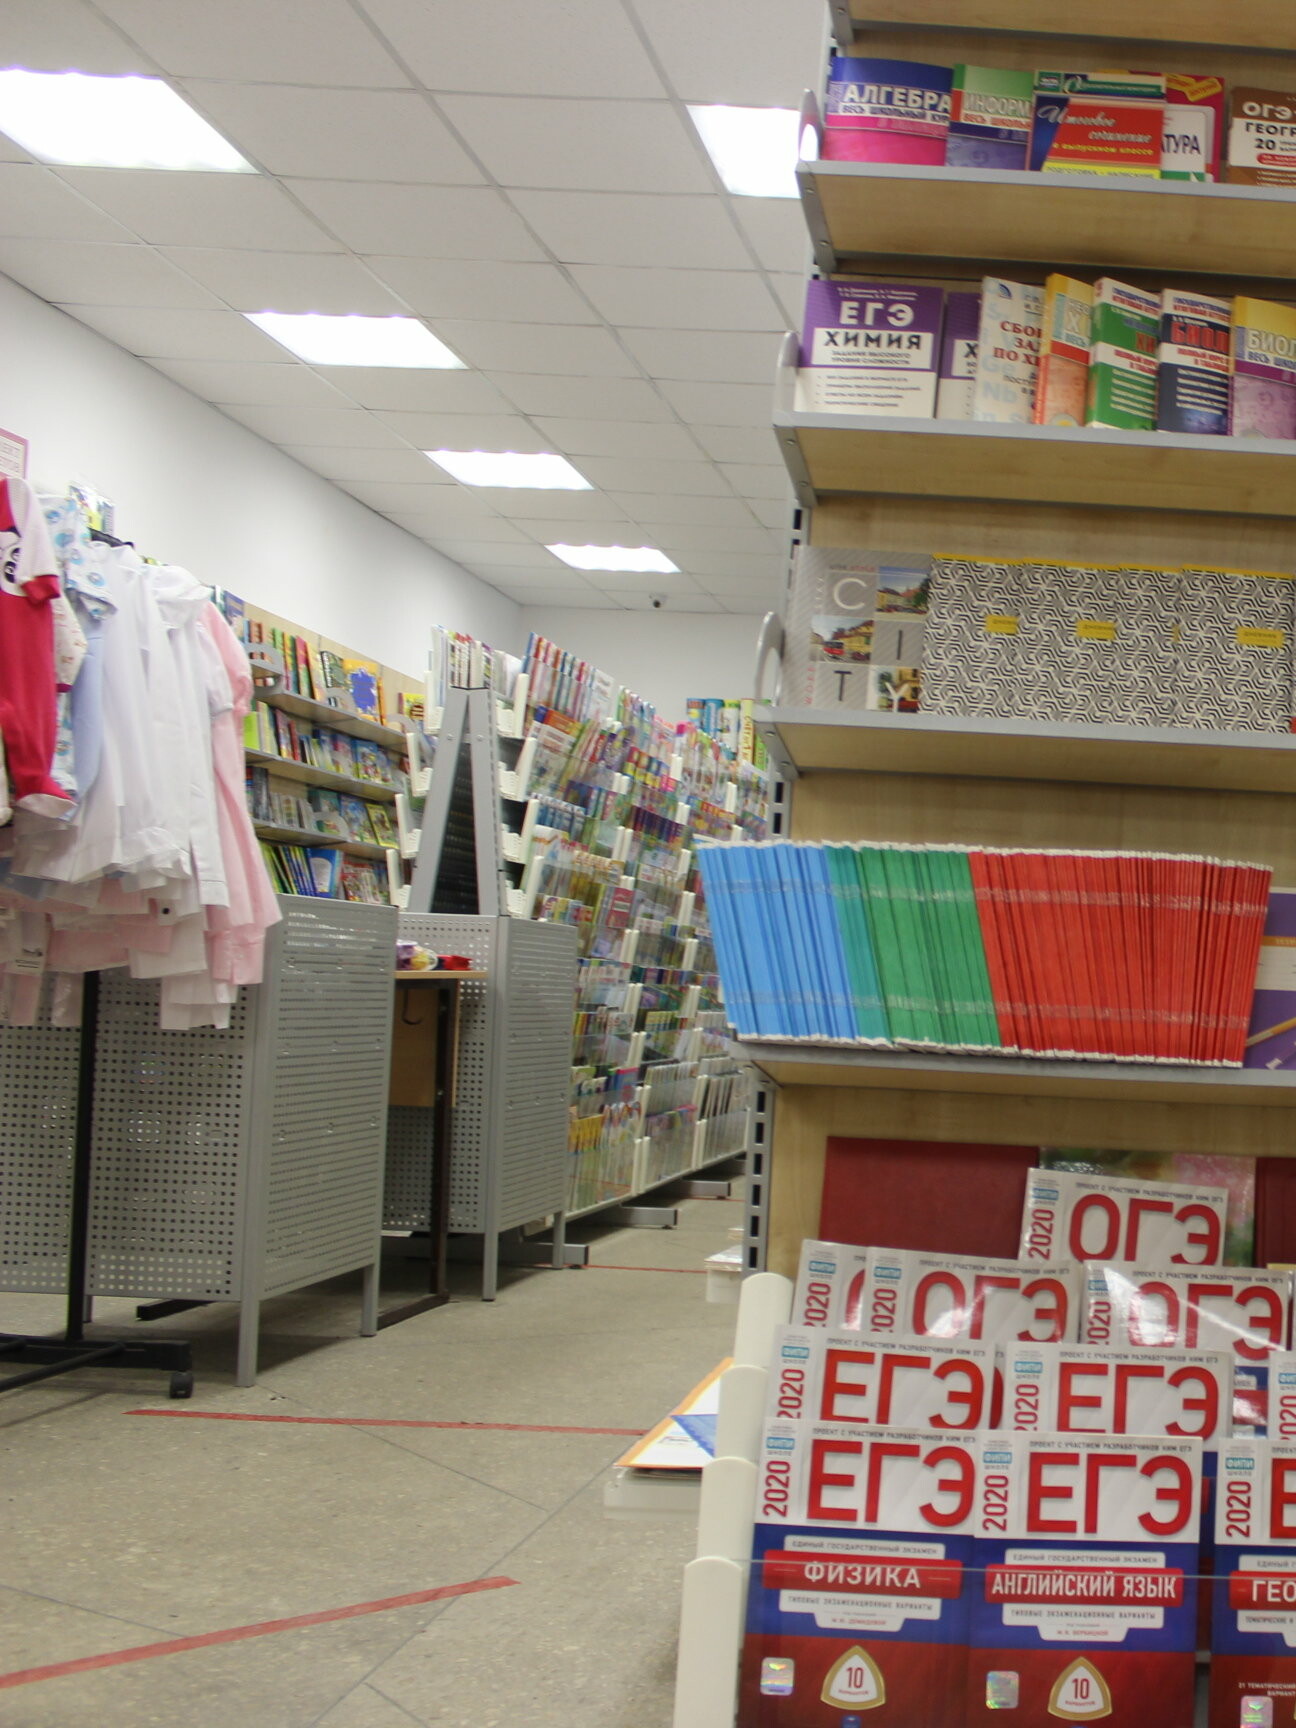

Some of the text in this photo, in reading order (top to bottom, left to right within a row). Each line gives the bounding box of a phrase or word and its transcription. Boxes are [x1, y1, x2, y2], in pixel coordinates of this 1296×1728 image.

[843, 84, 951, 112] АЛГЕБРА
[1254, 138, 1276, 151] 20
[839, 300, 914, 328] ЕГЭ
[824, 330, 921, 350] ХИМИЯ
[993, 347, 1019, 361] ПО
[1028, 1208, 1055, 1261] 2020
[1069, 1193, 1221, 1266] ОГЭ
[802, 1282, 831, 1327] 020
[870, 1288, 897, 1333] 020
[913, 1271, 1069, 1343] ОГЭ
[1087, 1300, 1112, 1345] 020
[1127, 1281, 1284, 1361] ОГЭ
[820, 1348, 985, 1430] ЕГЭ
[1057, 1362, 1219, 1441] ЕГЭ
[762, 1460, 791, 1518] 2020
[807, 1439, 976, 1527] ЕГЭ
[982, 1474, 1009, 1532] 2020
[1027, 1451, 1193, 1537] ЕГЭ
[1226, 1480, 1251, 1538] 2020
[804, 1561, 921, 1588] ФИЗИКА
[992, 1569, 1176, 1599] АНГЛИЙСКИЙ ЯЗЫК
[846, 1667, 864, 1689] 10
[1072, 1678, 1090, 1700] 10
